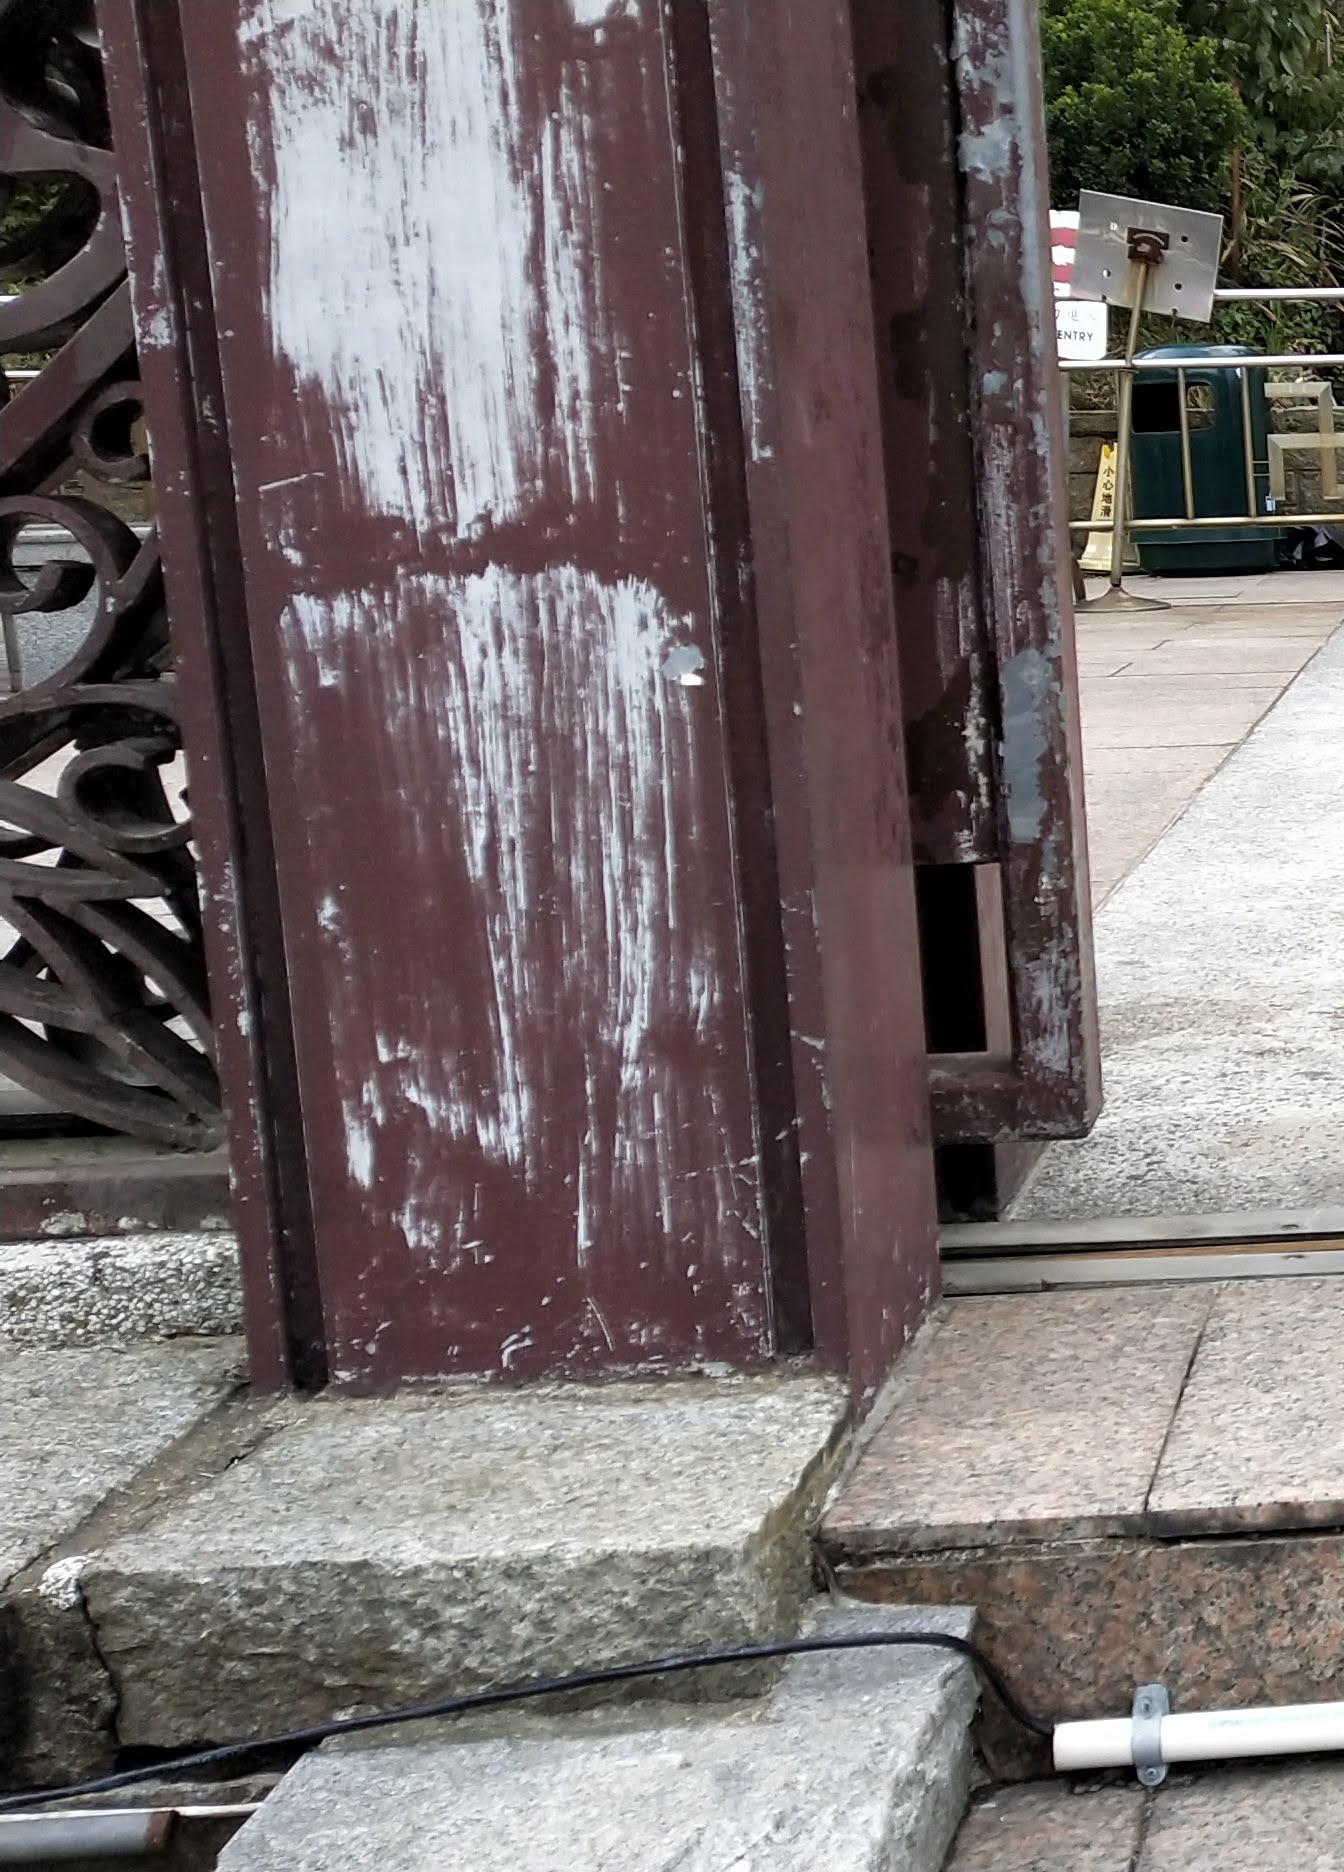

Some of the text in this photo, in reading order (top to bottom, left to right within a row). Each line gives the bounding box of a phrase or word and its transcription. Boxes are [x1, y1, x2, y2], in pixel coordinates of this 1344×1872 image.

[1057, 330, 1094, 341] ENTRY
[1100, 466, 1115, 517] 小心地滑
